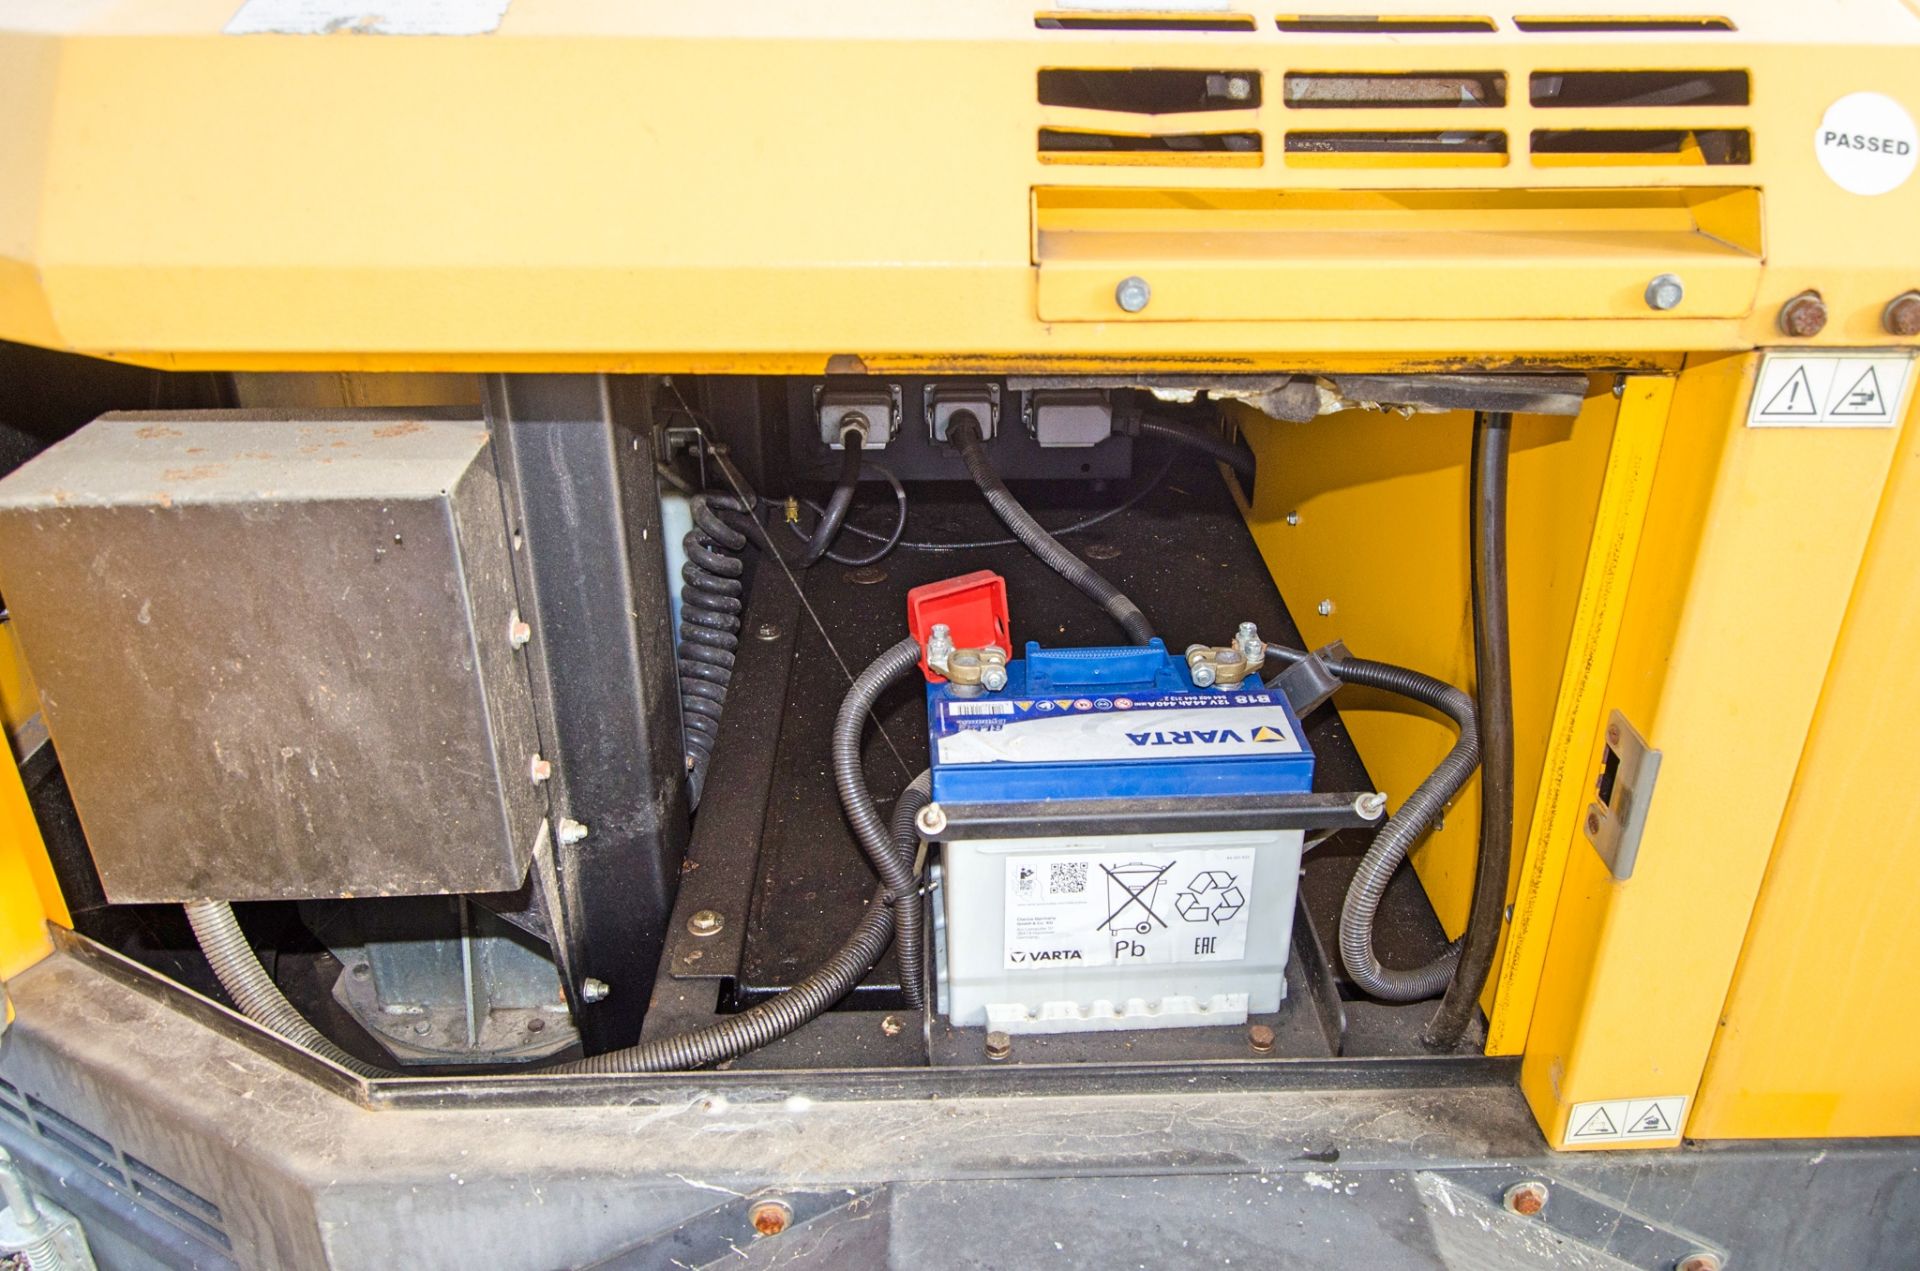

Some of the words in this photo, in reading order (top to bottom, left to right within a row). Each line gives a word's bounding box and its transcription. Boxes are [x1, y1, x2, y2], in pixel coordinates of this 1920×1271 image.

[1824, 130, 1911, 156] PASSED
[1234, 694, 1271, 704] B18
[1125, 729, 1246, 746] VARTA
[1115, 940, 1146, 959] Pb
[1194, 936, 1218, 955] EAC
[1029, 950, 1082, 961] VARTA
